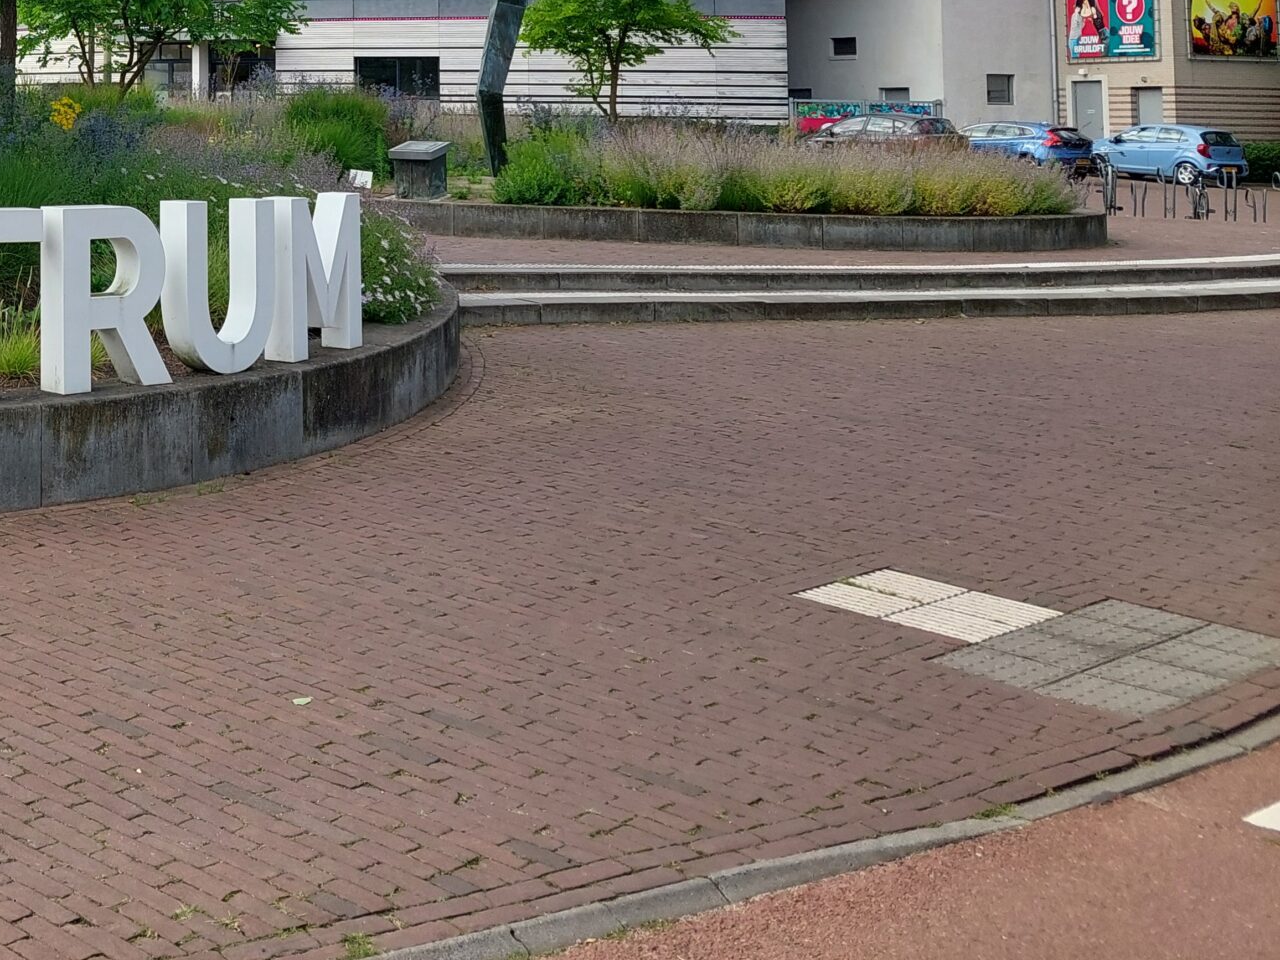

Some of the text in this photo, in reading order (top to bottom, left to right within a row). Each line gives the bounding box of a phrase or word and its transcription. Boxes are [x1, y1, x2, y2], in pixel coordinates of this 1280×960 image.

[1118, 25, 1143, 35] JOUW
[1079, 35, 1099, 44] JOUW
[1122, 34, 1141, 44] IDEE
[1074, 44, 1105, 54] BRUILOFT
